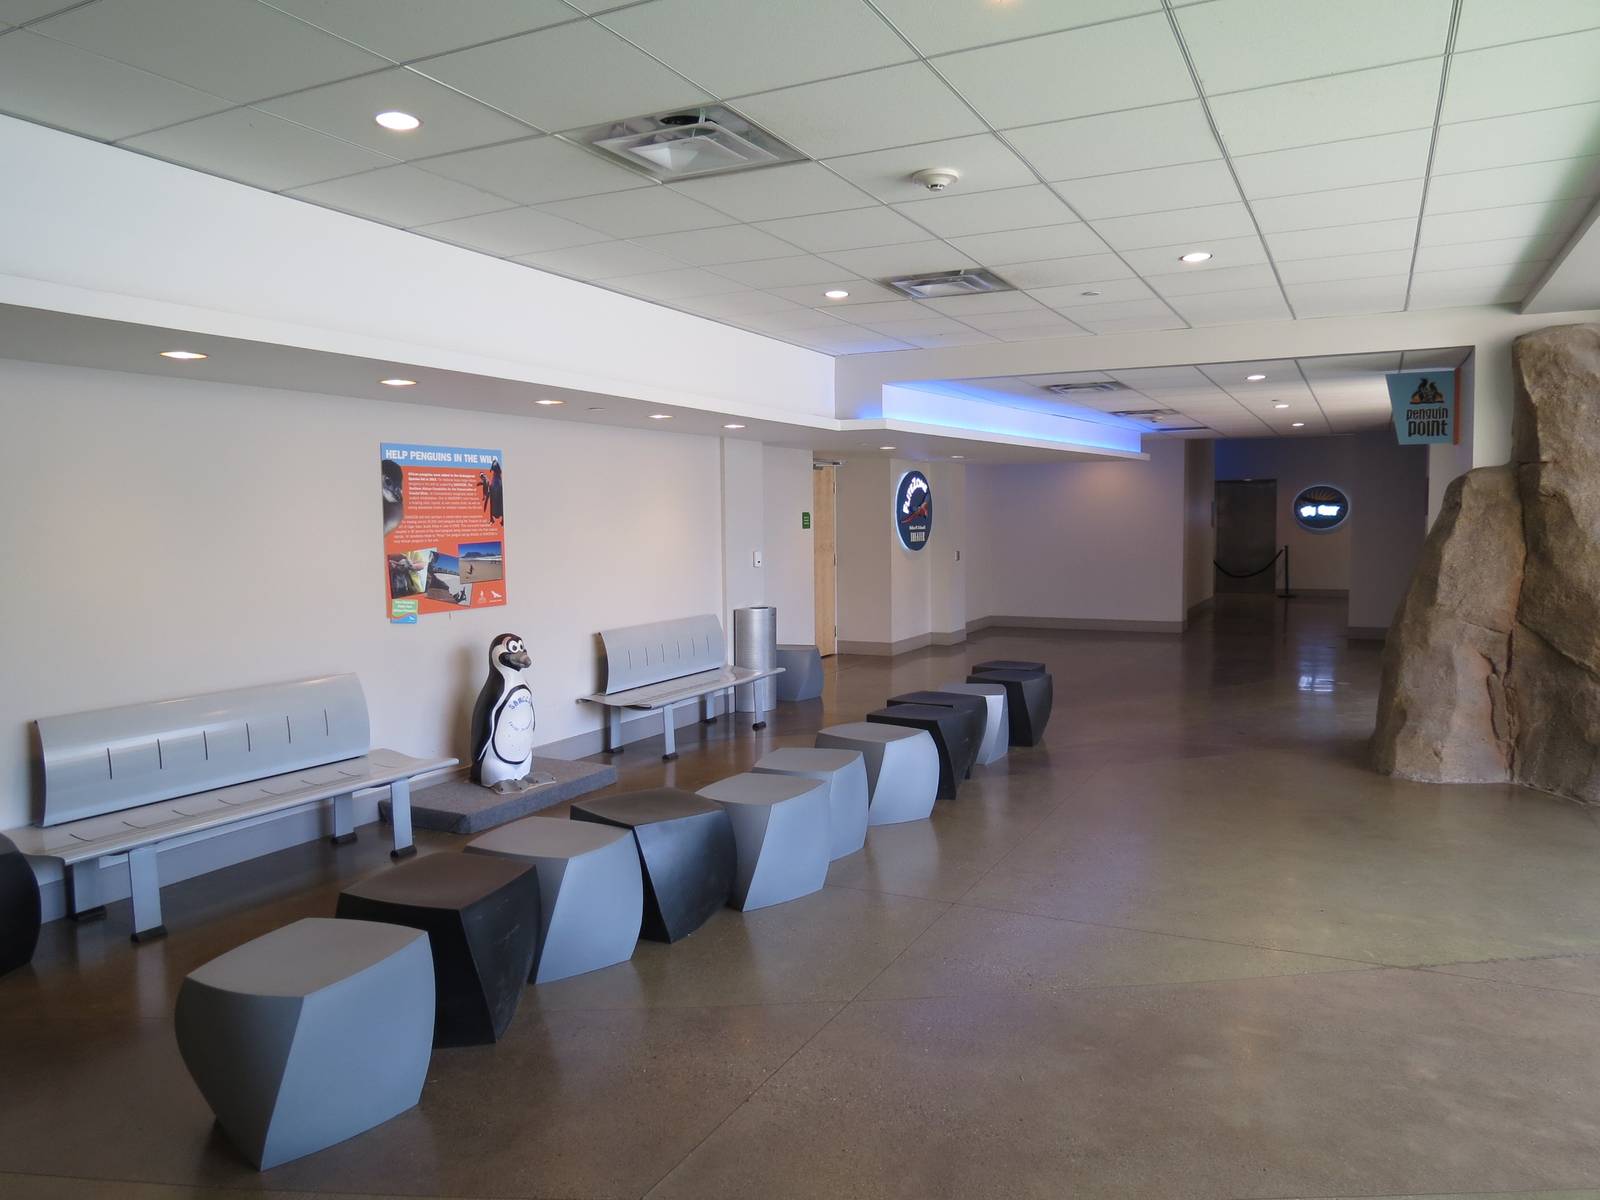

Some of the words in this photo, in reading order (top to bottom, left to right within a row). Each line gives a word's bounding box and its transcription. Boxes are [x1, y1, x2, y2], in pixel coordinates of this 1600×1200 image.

[1406, 407, 1449, 421] penguin
[1407, 420, 1449, 437] point
[385, 449, 408, 460] HELP
[410, 451, 452, 462] PENGUINS
[454, 453, 463, 462] IN
[464, 454, 478, 463] THE
